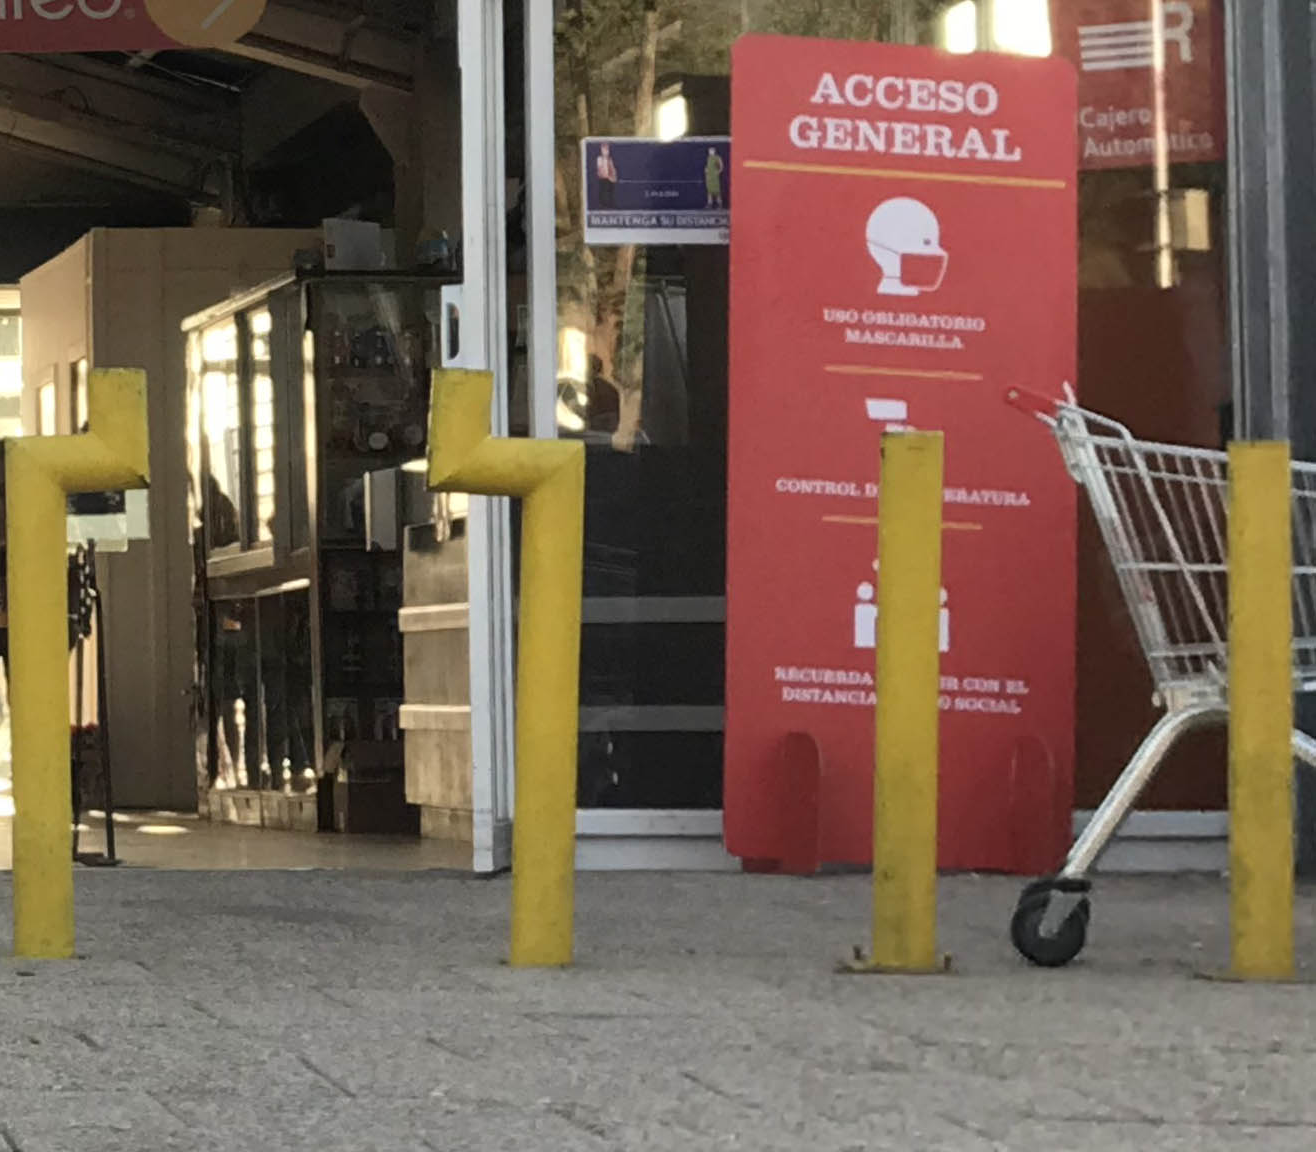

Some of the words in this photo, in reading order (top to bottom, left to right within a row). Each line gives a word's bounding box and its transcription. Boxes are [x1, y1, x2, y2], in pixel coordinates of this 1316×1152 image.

[810, 72, 999, 116] ACCESO
[1080, 106, 1152, 132] Cajero
[789, 115, 1022, 161] GENERAL
[1084, 131, 1215, 158] Automtico
[591, 216, 657, 226] MANTENGA
[823, 308, 858, 323] USO
[862, 310, 986, 332] OBLIGATORIO
[845, 328, 964, 349] MASCARILLA
[775, 477, 861, 497] CONTROL
[865, 482, 880, 498] D
[774, 667, 874, 686] RECUERDA
[963, 678, 999, 693] CON
[1006, 679, 1029, 694] EL
[954, 698, 1022, 714] SOCIAL
